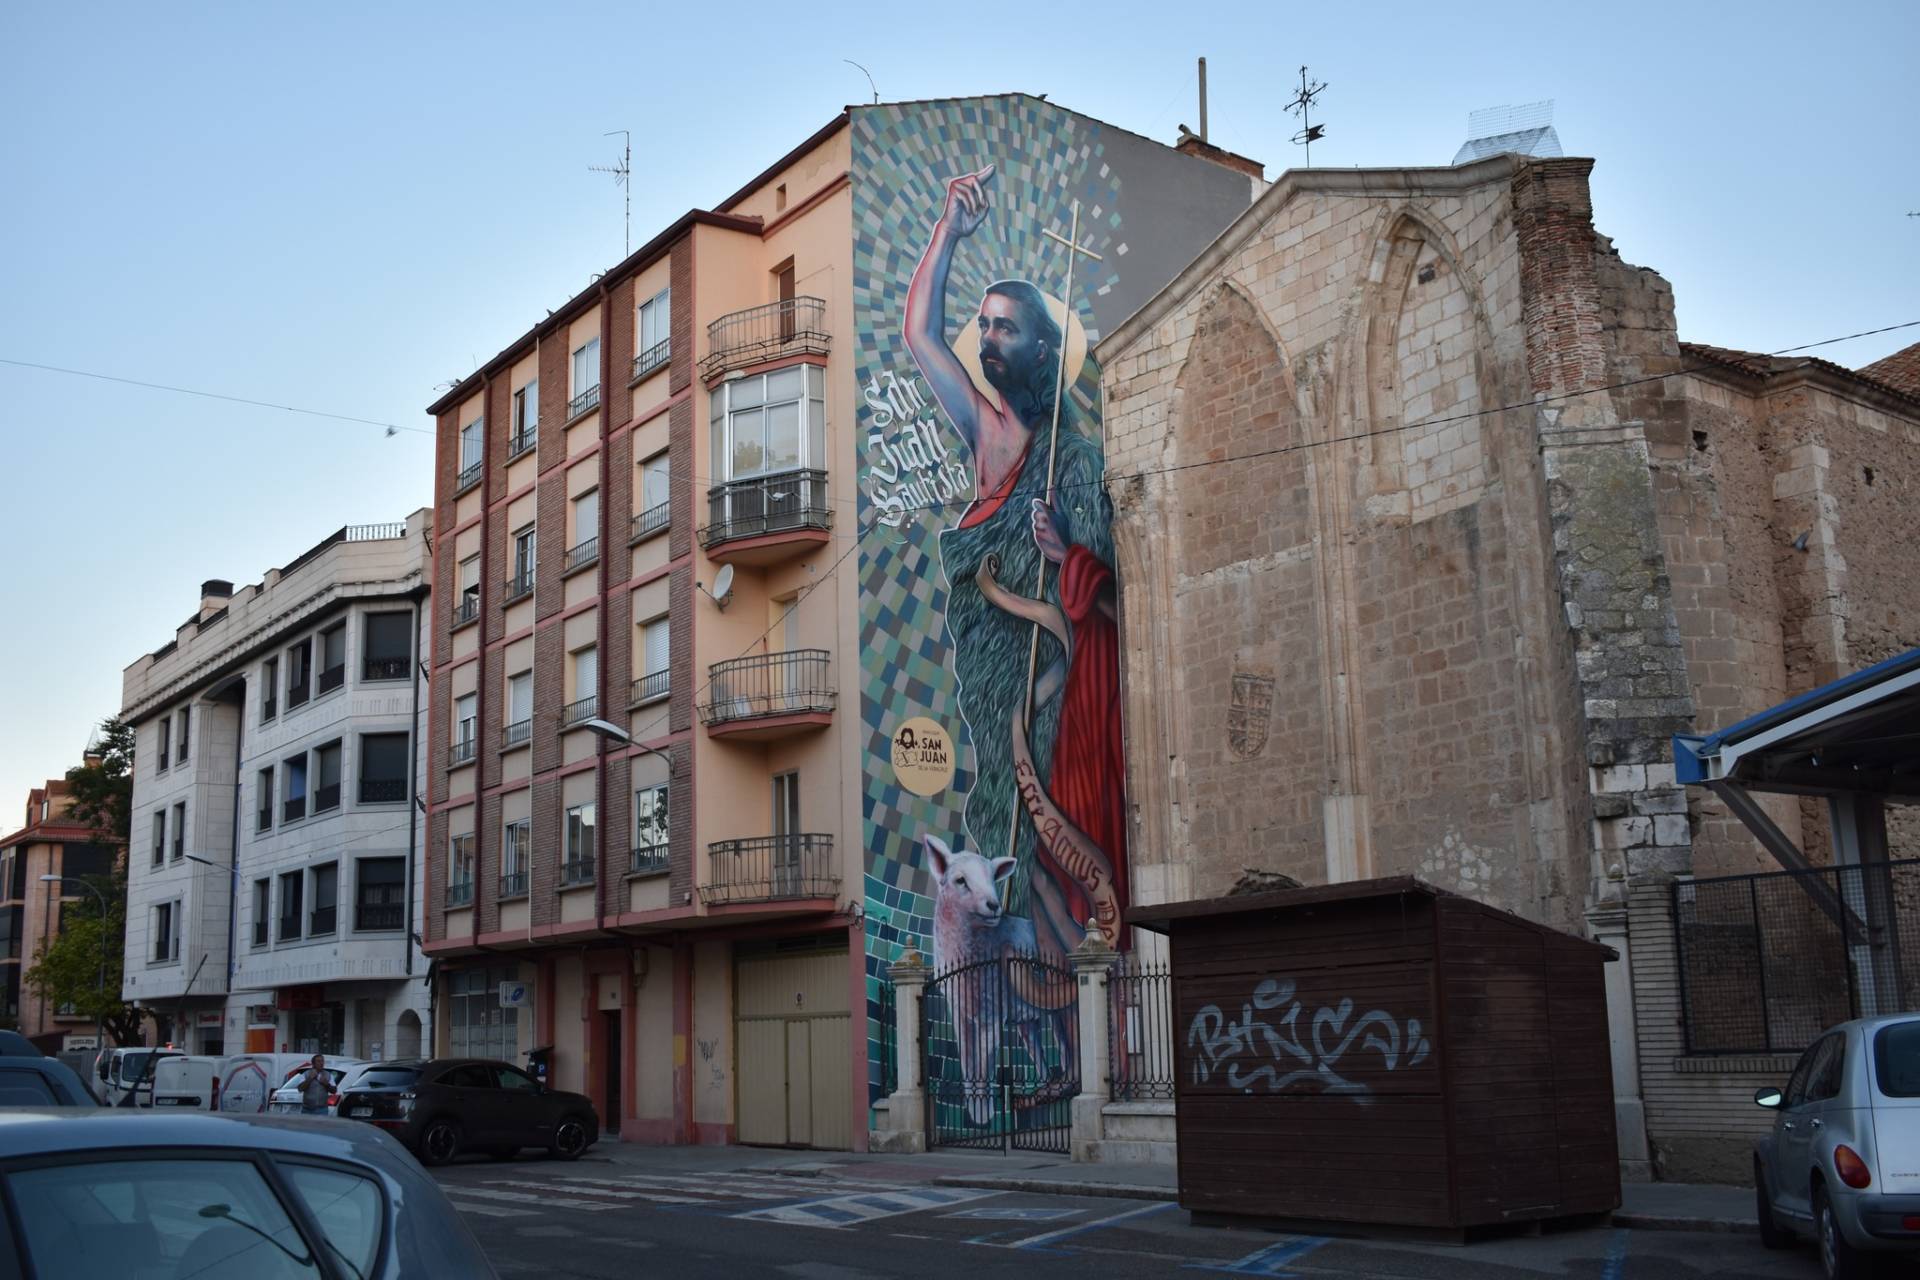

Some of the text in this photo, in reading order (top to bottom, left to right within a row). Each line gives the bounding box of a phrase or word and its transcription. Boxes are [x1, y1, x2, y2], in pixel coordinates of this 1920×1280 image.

[865, 370, 927, 427] San
[868, 418, 948, 483] Juan
[869, 461, 970, 527] Bautista
[920, 751, 946, 763] JUAN
[922, 737, 941, 750] SAN
